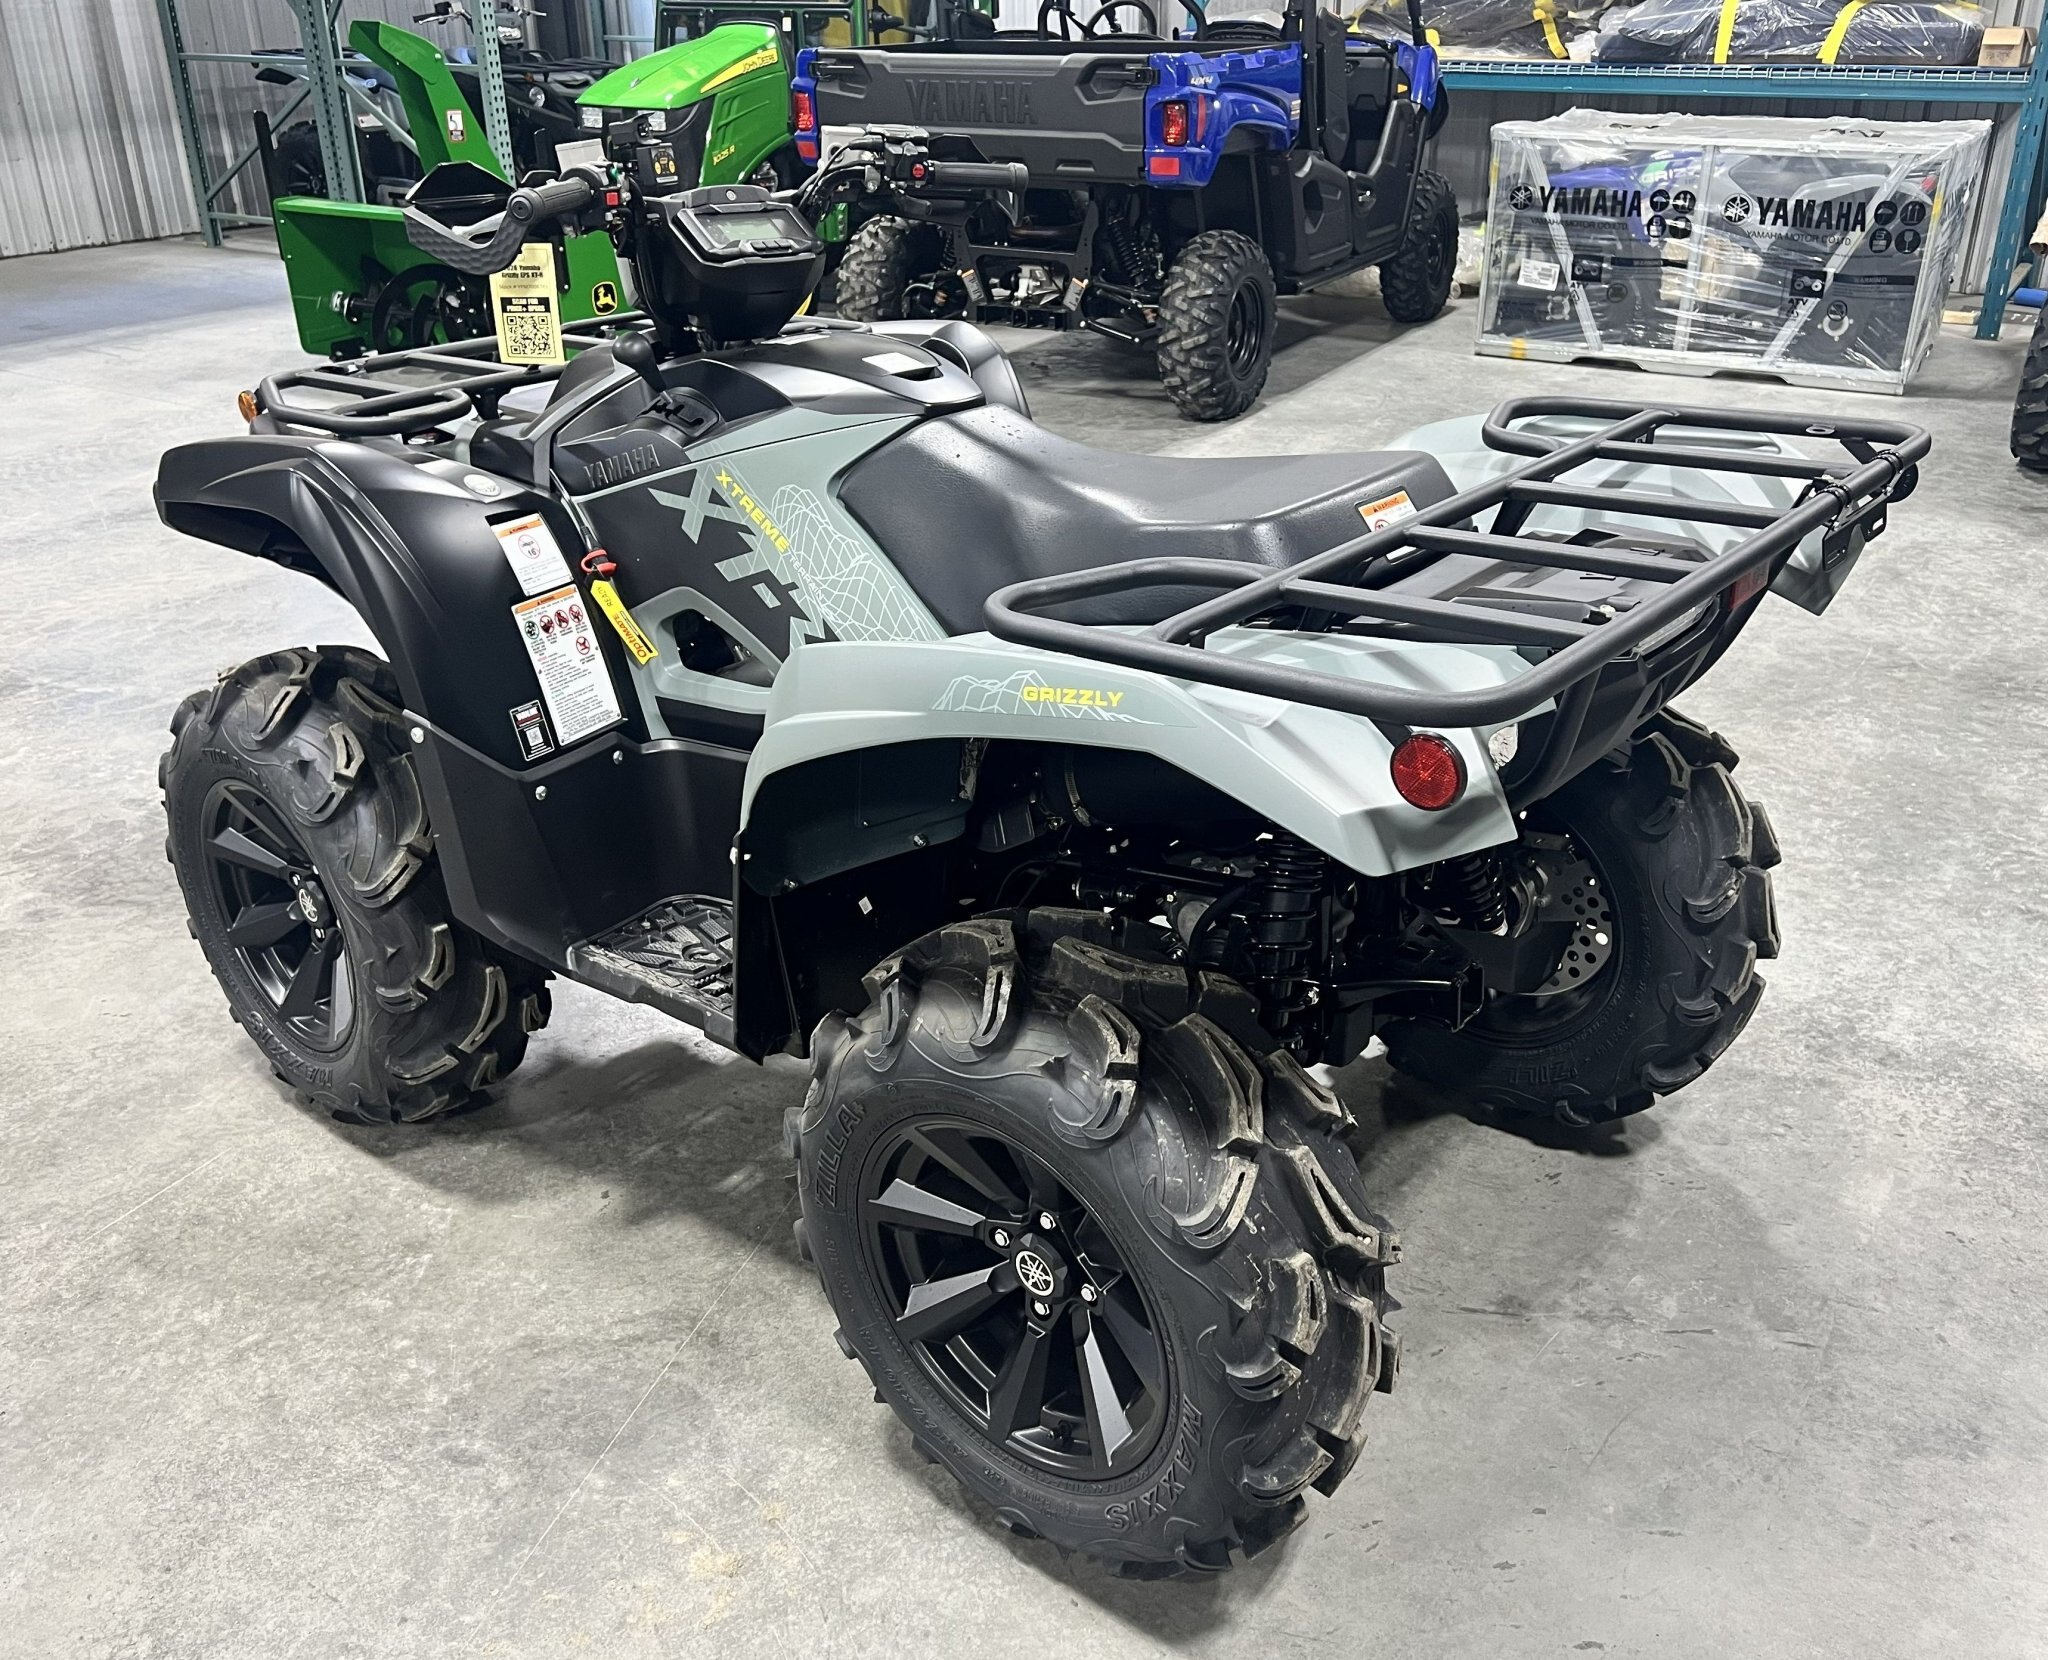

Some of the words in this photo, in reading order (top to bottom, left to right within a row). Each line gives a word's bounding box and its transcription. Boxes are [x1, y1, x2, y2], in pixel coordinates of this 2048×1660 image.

[742, 61, 757, 73] JOHN
[757, 53, 775, 65] DEERE
[904, 79, 1040, 124] YAMAHA
[1539, 186, 1642, 217] YAMAHA
[1757, 197, 1866, 232] YAMAHA
[1746, 229, 1784, 241] YAMAHA
[583, 443, 661, 488] YAMAHA
[715, 468, 790, 553] XTREME
[788, 554, 825, 602] TERRAIN
[1022, 685, 1124, 707] GRIZZLY
[1104, 1393, 1203, 1533] MAXXIS
